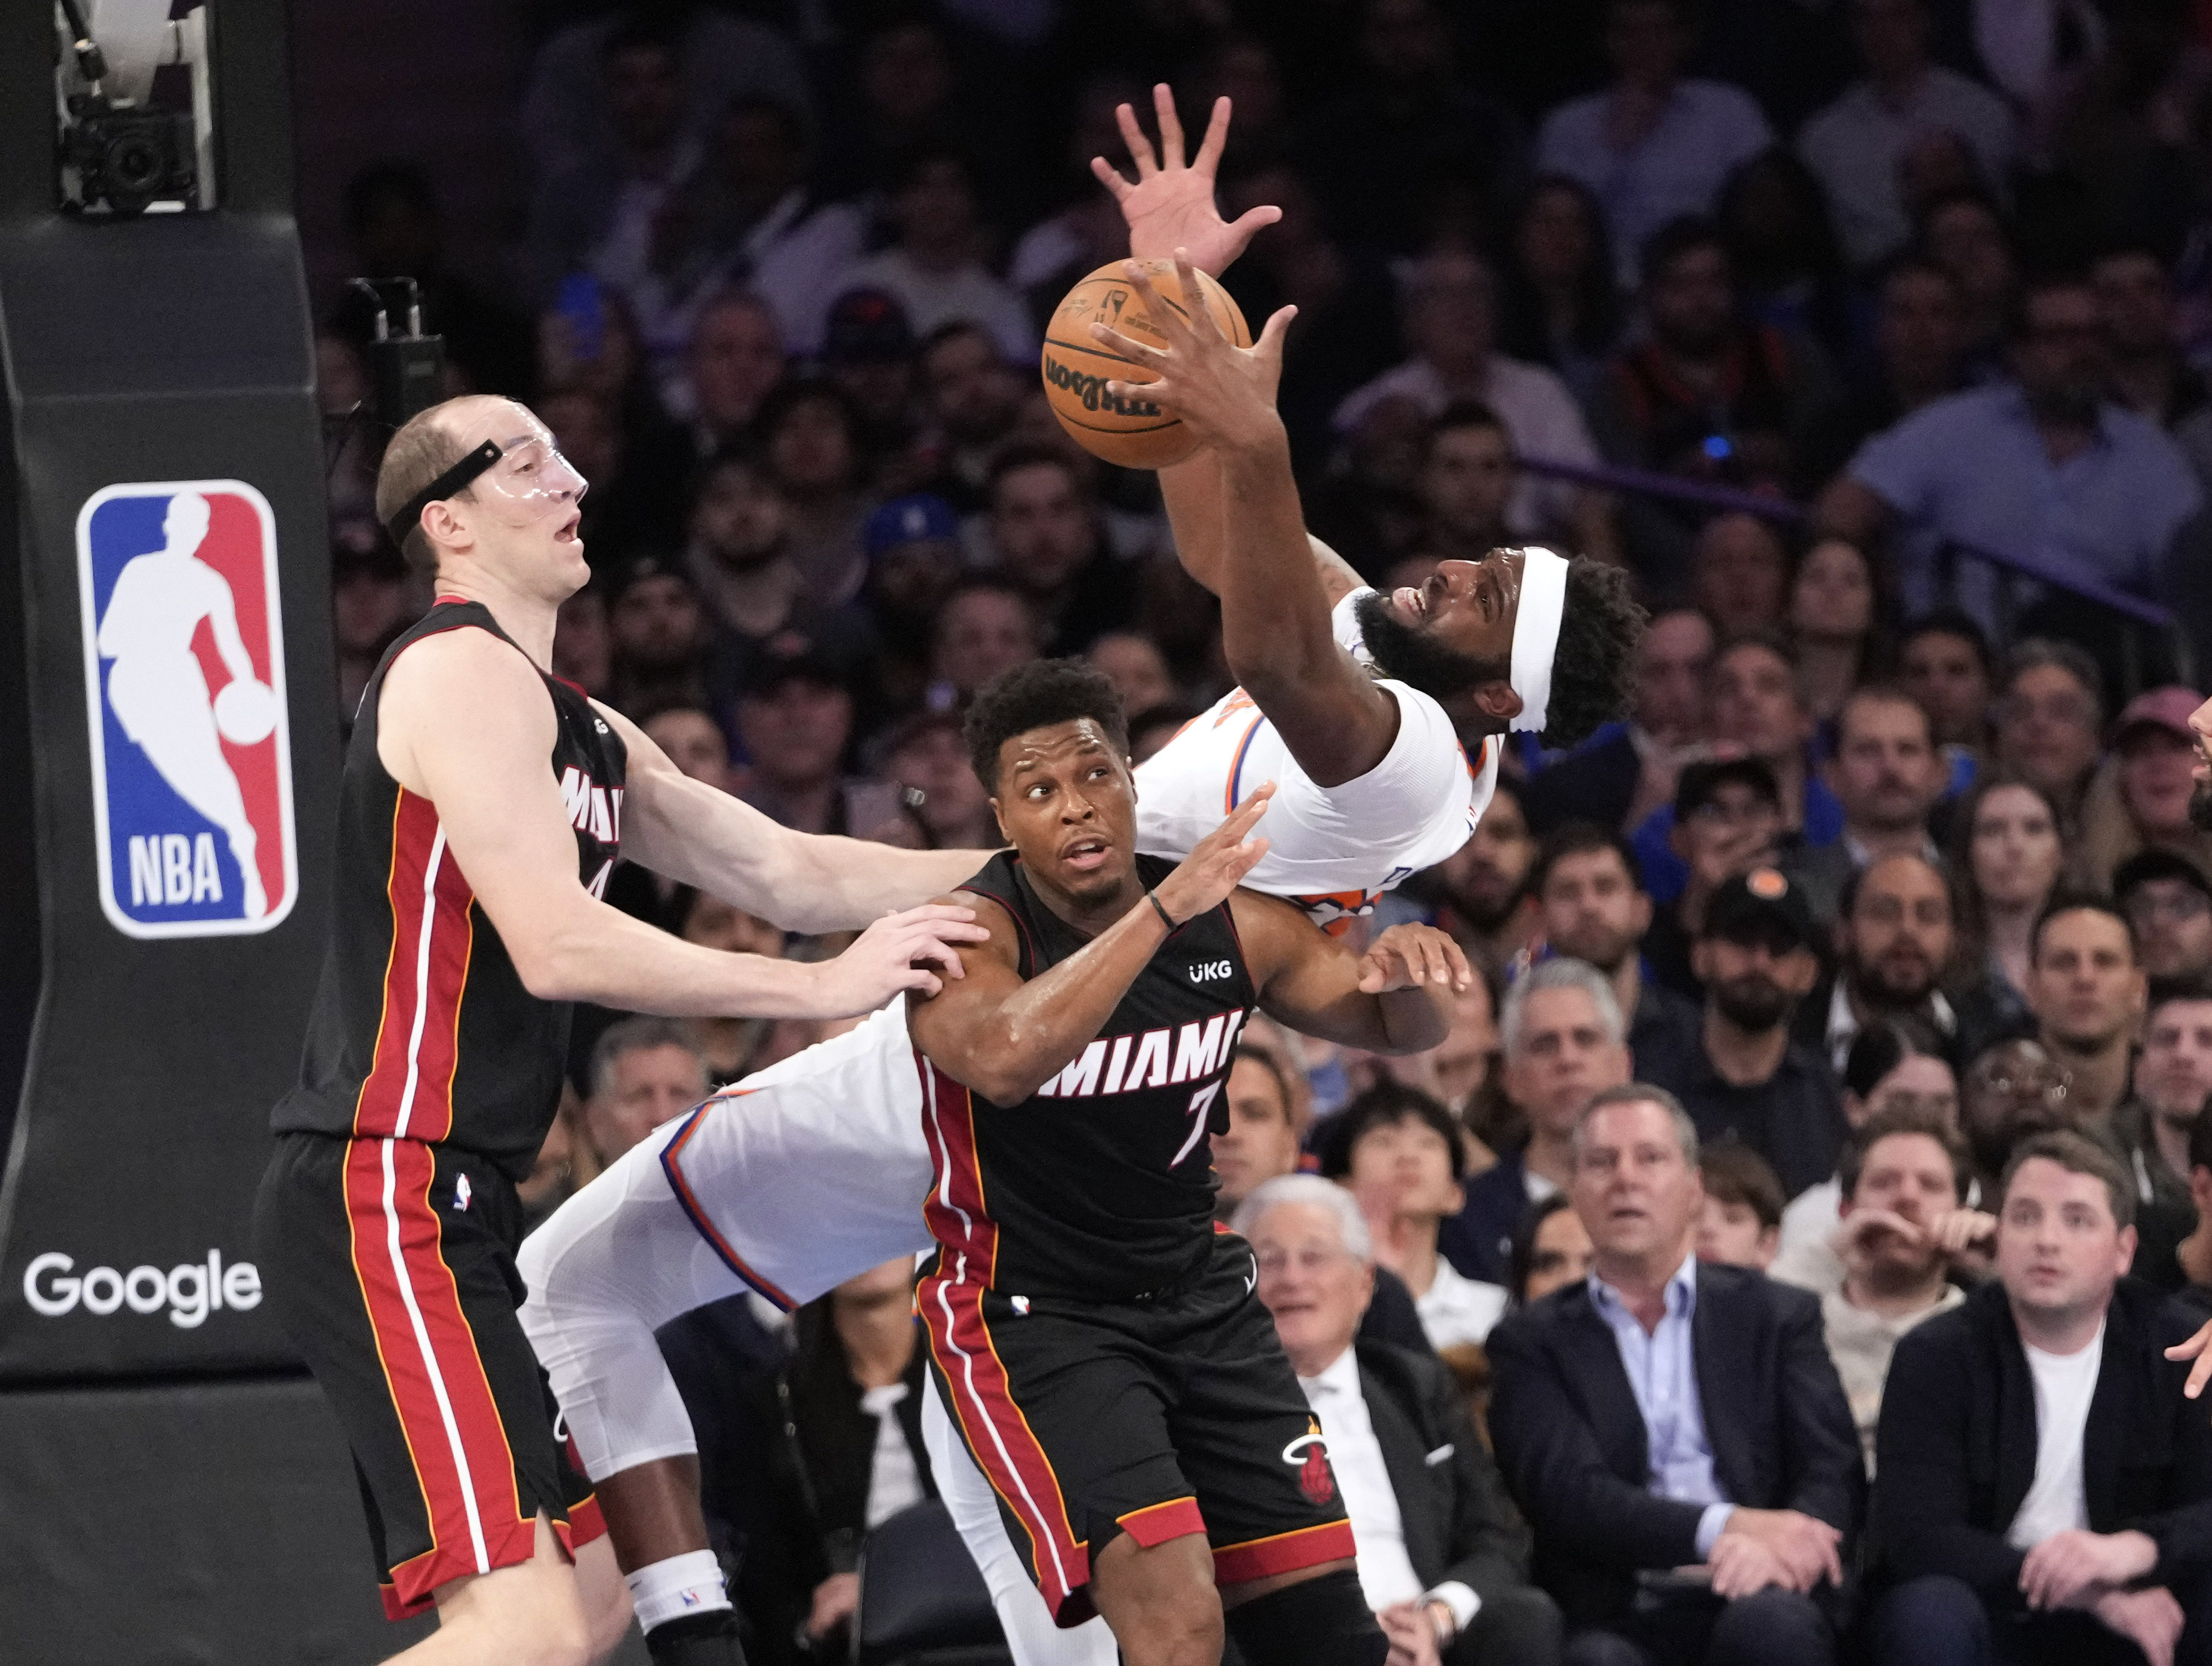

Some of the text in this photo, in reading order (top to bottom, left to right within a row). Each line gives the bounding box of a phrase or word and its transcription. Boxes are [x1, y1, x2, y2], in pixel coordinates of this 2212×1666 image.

[129, 832, 223, 907] NBA
[1037, 1007, 1244, 1097] MIAMI
[1168, 1076, 1223, 1170] 7
[23, 1248, 263, 1328] Google
